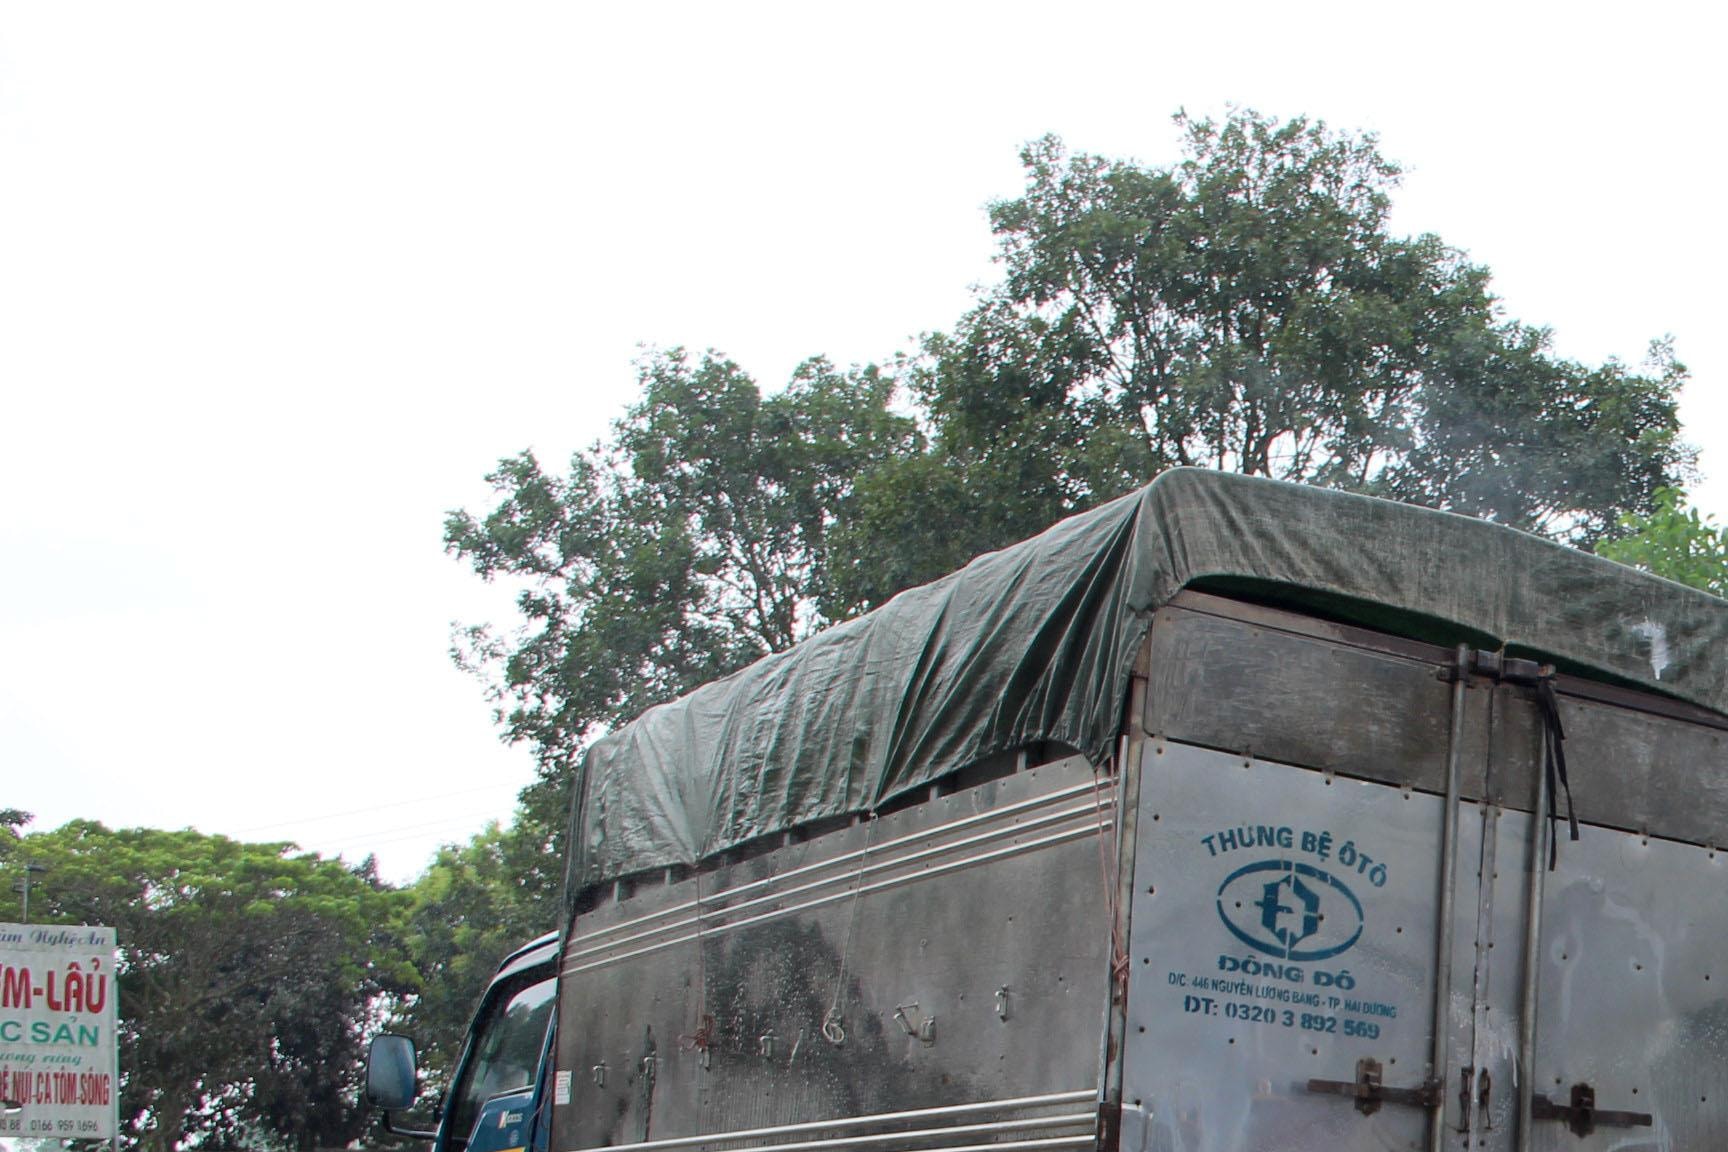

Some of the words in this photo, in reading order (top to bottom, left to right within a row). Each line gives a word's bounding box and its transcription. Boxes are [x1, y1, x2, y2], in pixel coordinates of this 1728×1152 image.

[1338, 840, 1387, 888] ÔTÔ
[0, 957, 107, 1014] M-LẨU
[31, 1016, 99, 1047] SẢN
[1225, 1002, 1276, 1024] 0320
[1282, 1009, 1294, 1027] 3
[1300, 1013, 1337, 1033] 892
[1344, 1019, 1380, 1039] 569
